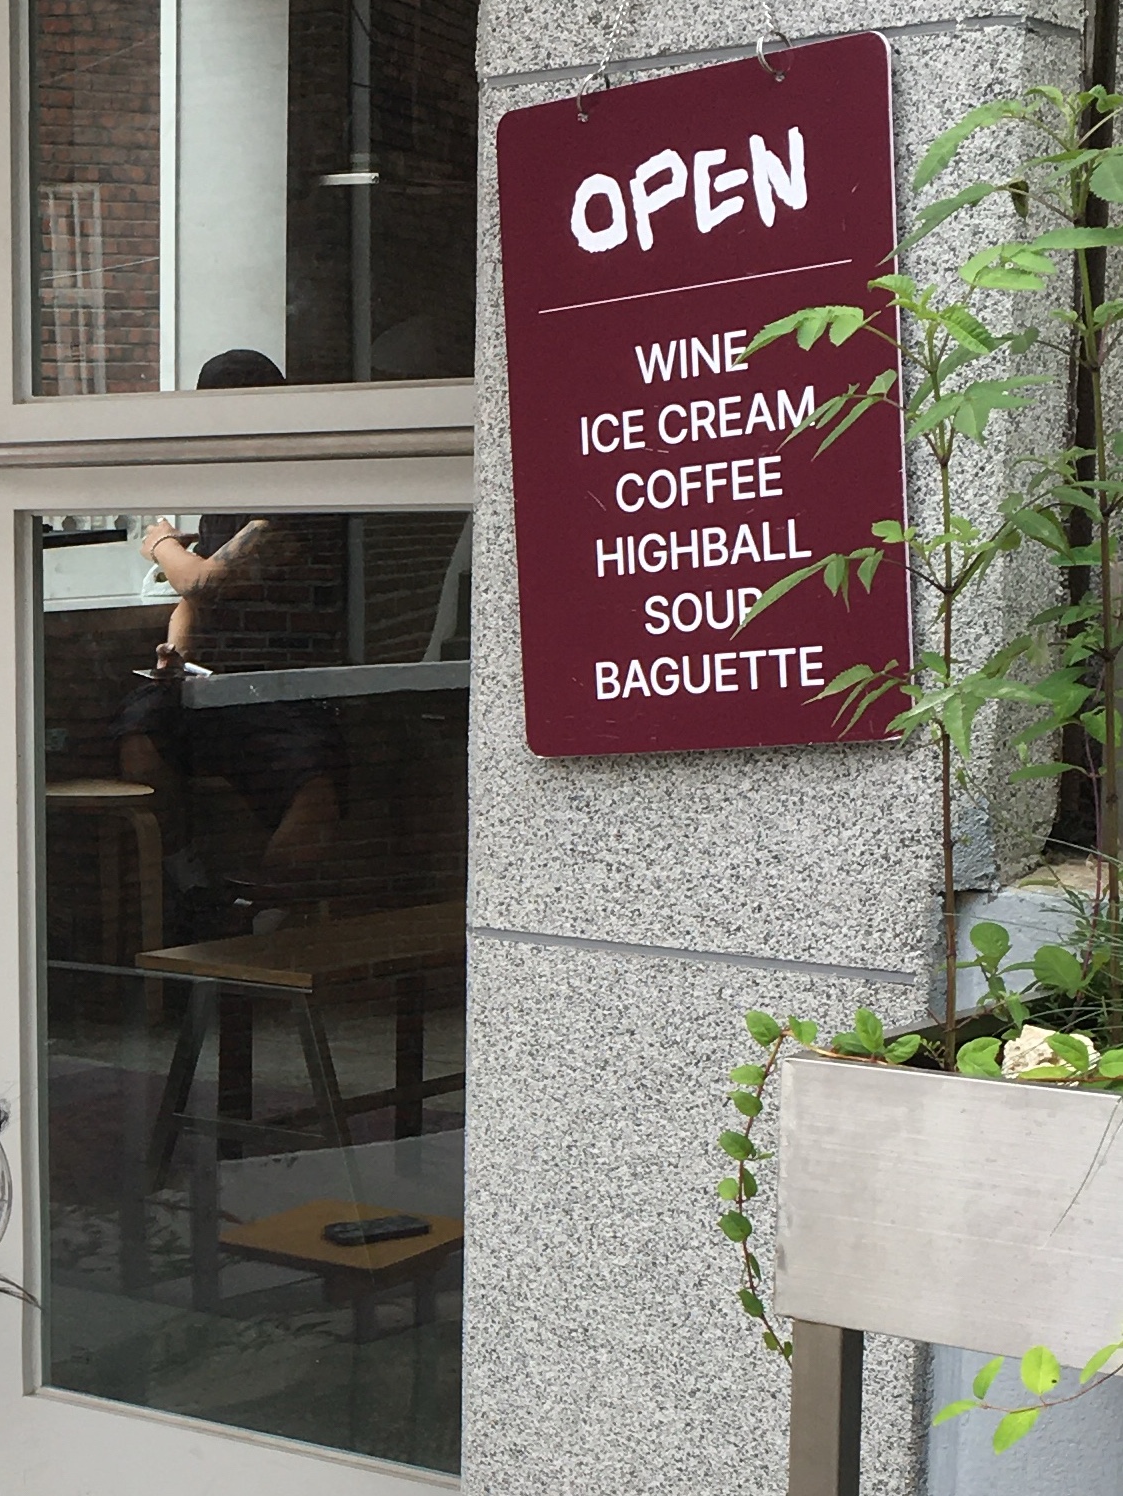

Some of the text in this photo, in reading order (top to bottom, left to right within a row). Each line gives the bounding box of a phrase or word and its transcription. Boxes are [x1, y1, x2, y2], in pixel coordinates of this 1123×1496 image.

[570, 126, 808, 253] OPEN
[634, 329, 749, 384] WINE
[580, 385, 816, 456] ICE CREAM
[615, 455, 783, 513] COFFEE
[596, 518, 812, 578] HIGHBALL
[644, 587, 763, 635] SOUP
[595, 645, 825, 700] BAGUETTE
